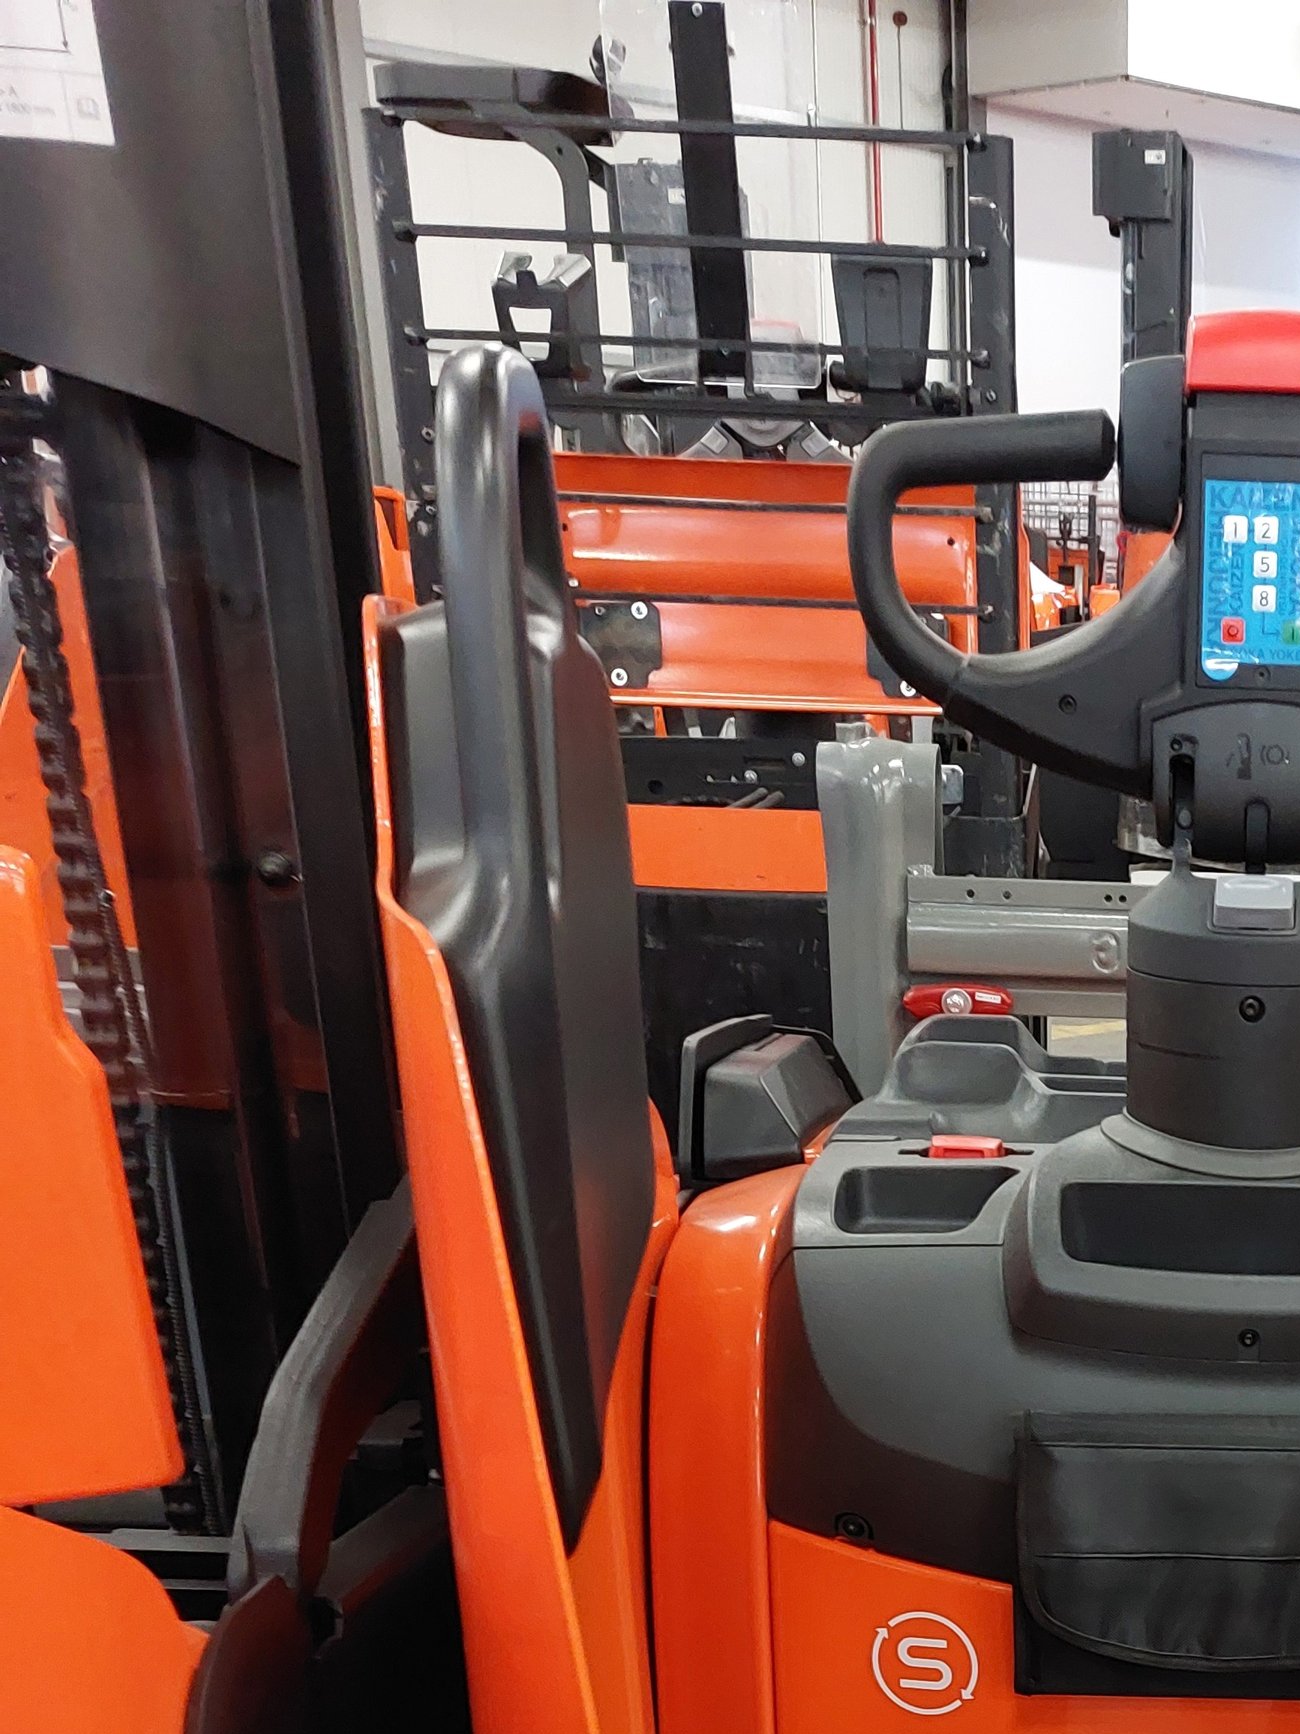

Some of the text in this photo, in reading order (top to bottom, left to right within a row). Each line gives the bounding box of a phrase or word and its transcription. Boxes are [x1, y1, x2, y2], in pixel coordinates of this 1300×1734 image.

[1232, 522, 1239, 539] 1
[1261, 523, 1271, 540] 2
[1260, 557, 1270, 573] 5
[1259, 591, 1269, 607] 8
[897, 1636, 953, 1691] S
